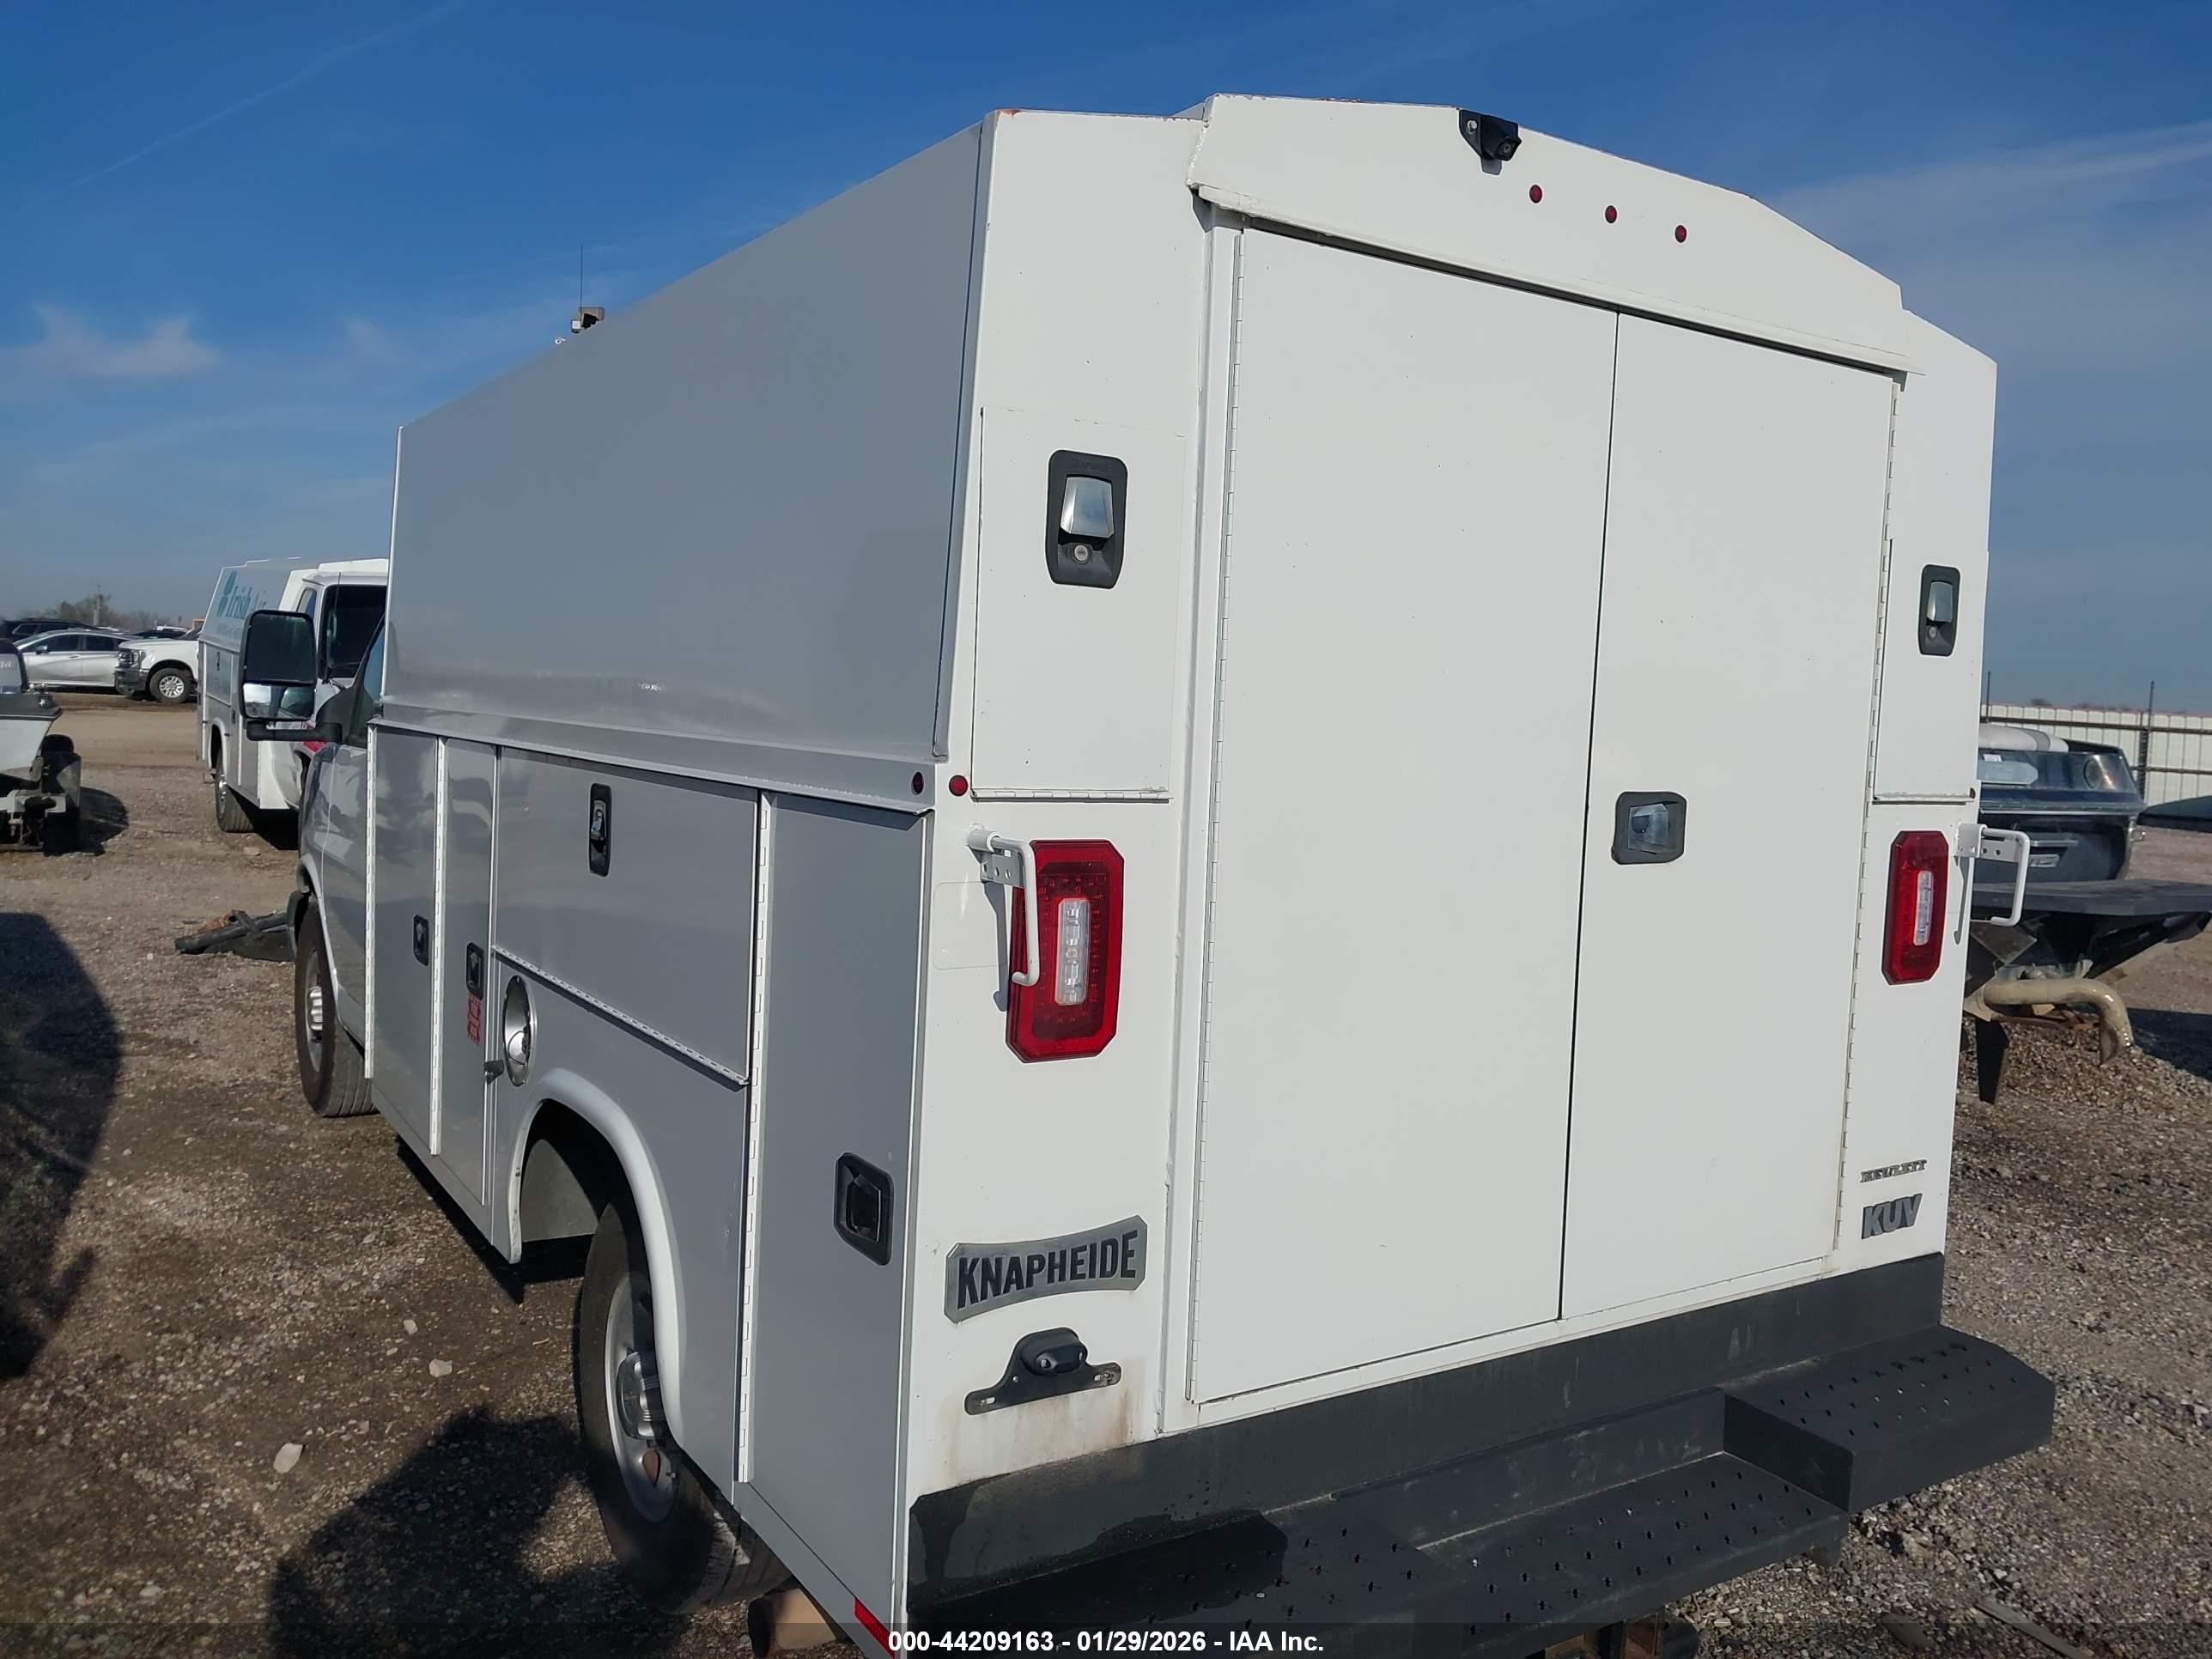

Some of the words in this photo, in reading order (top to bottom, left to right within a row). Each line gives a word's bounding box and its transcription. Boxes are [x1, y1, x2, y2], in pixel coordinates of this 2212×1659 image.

[224, 585, 252, 620] Irish
[1861, 1193, 1923, 1239] KUV
[957, 1229, 1139, 1310] KNAPHEIDE
